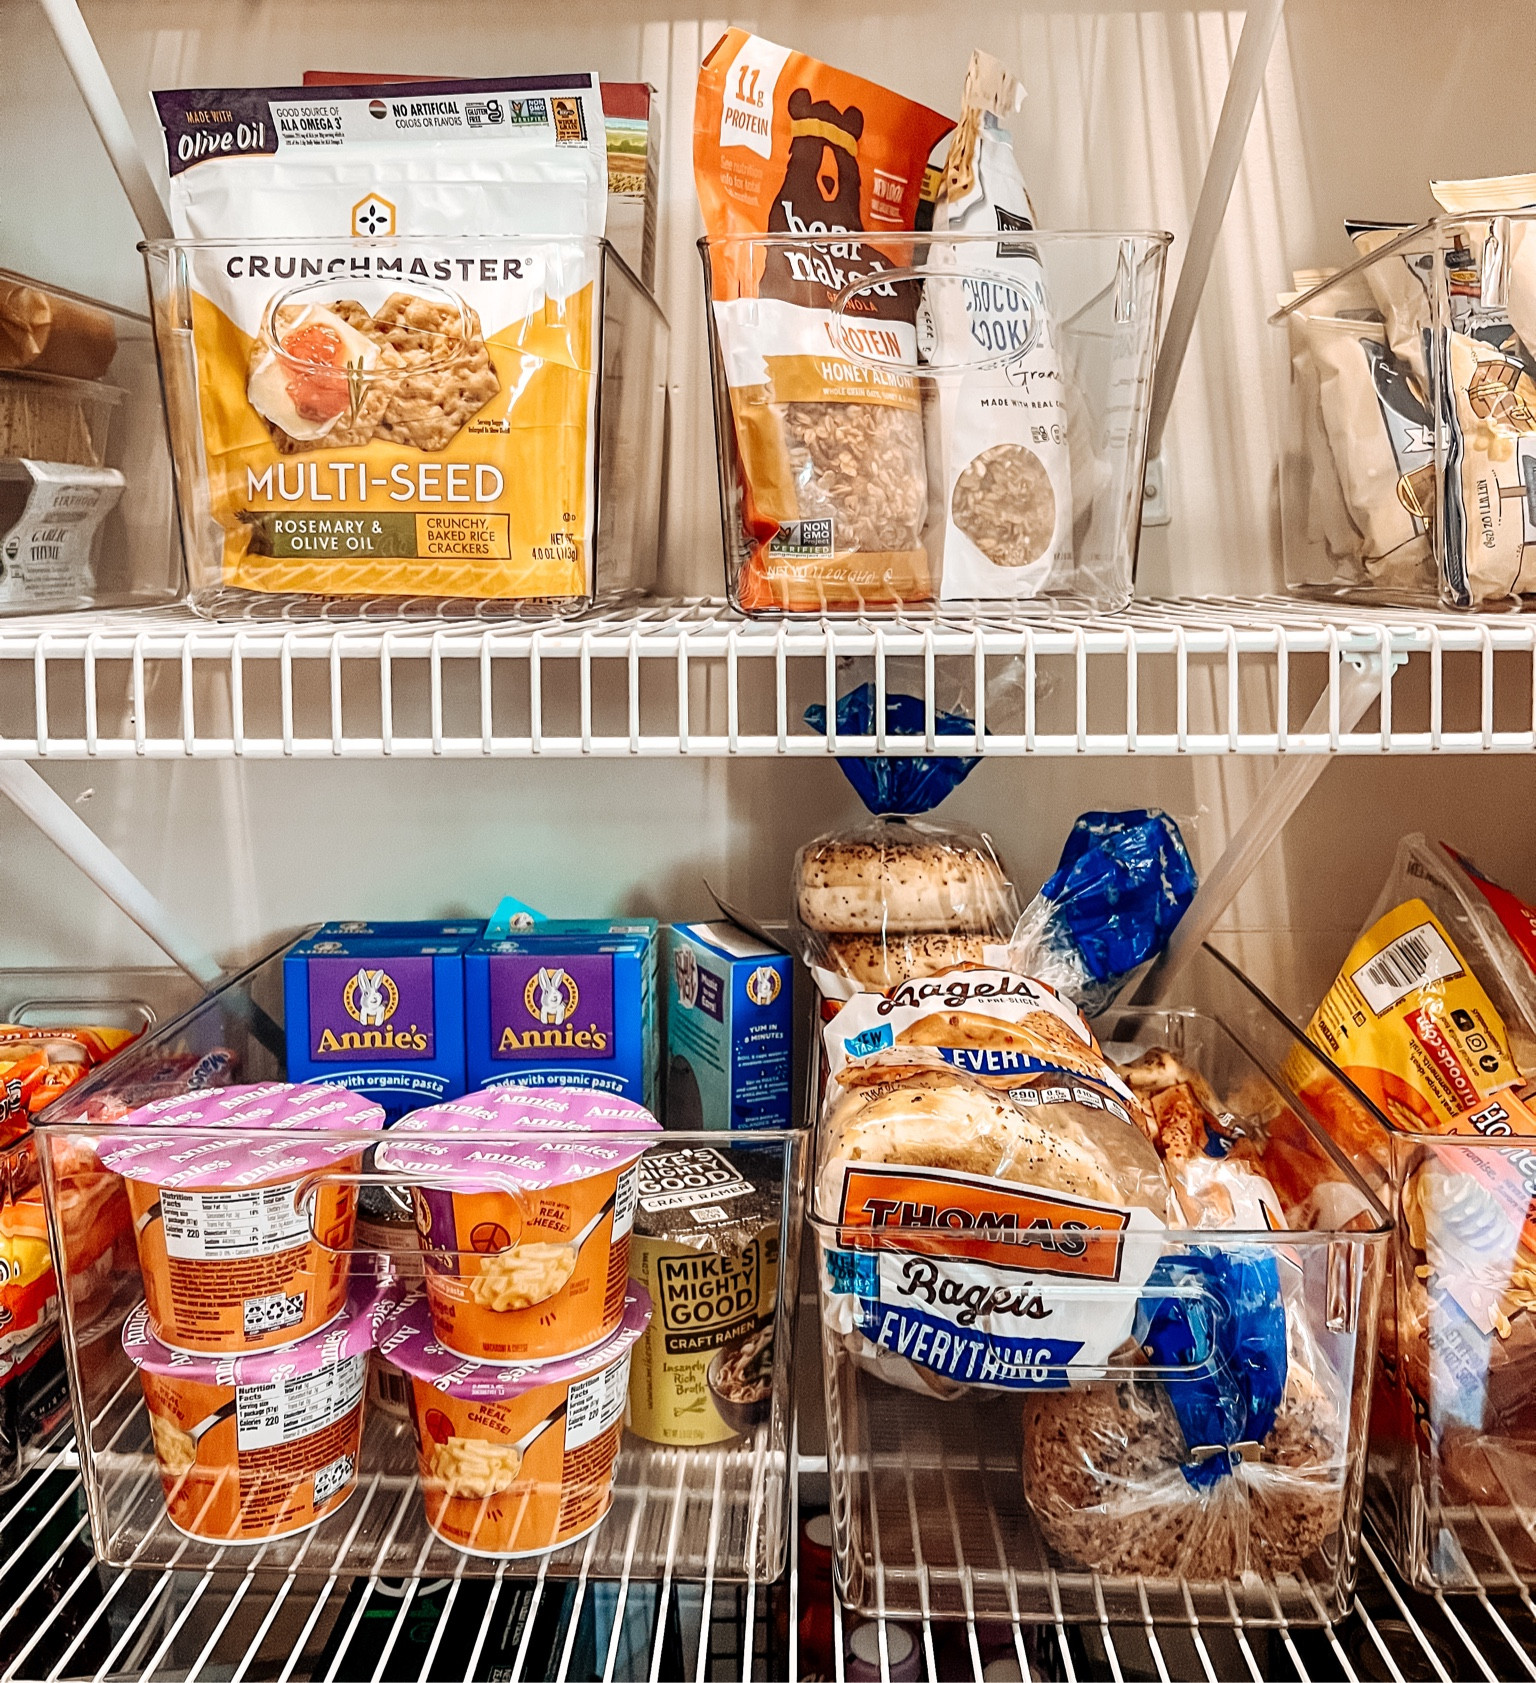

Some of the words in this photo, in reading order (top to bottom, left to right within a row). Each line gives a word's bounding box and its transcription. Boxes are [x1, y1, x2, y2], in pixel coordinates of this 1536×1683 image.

[276, 107, 299, 118] GOOD
[300, 106, 328, 117] SOURCE
[329, 106, 340, 116] OF
[392, 104, 408, 117] NO
[410, 101, 461, 117] ARTIFICIAL
[467, 108, 488, 116] GLUTEN
[185, 110, 211, 123] MADE
[213, 110, 234, 122] WITH
[395, 117, 422, 128] COLORS
[423, 118, 433, 128] OR
[434, 116, 463, 127] FLAVORS
[469, 115, 482, 123] FREE
[724, 106, 769, 137] PROTEIN
[280, 118, 298, 131] ALA
[300, 118, 334, 131] OMEGA
[178, 132, 233, 162] Olive
[236, 122, 265, 149] Oil
[720, 154, 733, 171] See
[781, 200, 862, 261] bear
[783, 251, 898, 297] naked
[820, 361, 870, 383] HONEY
[822, 387, 846, 396] WHOLE
[980, 398, 1009, 408] MADE
[1010, 399, 1029, 408] WITH
[1031, 400, 1054, 409] REAL
[246, 462, 505, 503] MULTI-SEED
[274, 519, 366, 535] ROSEMARY
[371, 520, 383, 535] &
[426, 517, 489, 532] CRUNCHY,
[803, 521, 830, 531] NON
[427, 530, 467, 542] BAKED
[469, 531, 496, 543] RICE
[550, 533, 564, 545] NET
[803, 530, 830, 540] GMO
[291, 536, 339, 551] OLIVE
[345, 536, 375, 551] OIL
[427, 542, 490, 555] CRACKERS
[773, 545, 830, 554] VERIFIED
[532, 548, 544, 561] 4.0
[767, 565, 788, 578] NET
[749, 1024, 768, 1034] YUM
[768, 1023, 778, 1031] IN
[317, 1023, 429, 1054] Annie's
[497, 1022, 608, 1052] Annie's
[750, 1032, 784, 1043] MINUTES
[1409, 1039, 1424, 1057] visit
[339, 1074, 366, 1088] with
[366, 1074, 411, 1089] organic
[411, 1076, 444, 1094] pasta
[517, 1075, 545, 1087] with
[547, 1074, 591, 1088] organic
[591, 1076, 624, 1093] pasta
[1424, 1075, 1442, 1100] recipe
[1010, 1090, 1036, 1099] 290
[638, 1169, 733, 1194] GOOD
[161, 1191, 194, 1202] Nutrition
[648, 1195, 694, 1208] CRAFT
[699, 1182, 751, 1200] RAMEN
[162, 1199, 182, 1209] Facts
[539, 1199, 556, 1207] MADE
[556, 1202, 571, 1210] WITH
[539, 1207, 566, 1221] REAL
[186, 1228, 200, 1239] 220
[667, 1267, 755, 1302] MIGHTY
[896, 1257, 1054, 1327] Bagels
[670, 1288, 753, 1325] GOOD
[669, 1335, 714, 1350] CRAFT
[715, 1319, 756, 1344] RAMEN
[876, 1310, 1052, 1383] EVERYTHING
[662, 1359, 706, 1375] Insanely
[673, 1370, 697, 1384] Rich
[238, 1383, 276, 1395] Nutrition
[570, 1376, 600, 1394] Nutrition
[238, 1393, 262, 1402] Facts
[569, 1389, 589, 1401] Facts
[239, 1402, 258, 1410] Serving
[258, 1400, 270, 1408] size
[496, 1403, 513, 1414] WITH
[243, 1408, 265, 1418] package
[479, 1405, 506, 1422] REAL
[588, 1408, 600, 1421] 220
[239, 1418, 262, 1427] Calories
[265, 1416, 280, 1427] 220
[467, 1412, 513, 1437] CHEESE!
